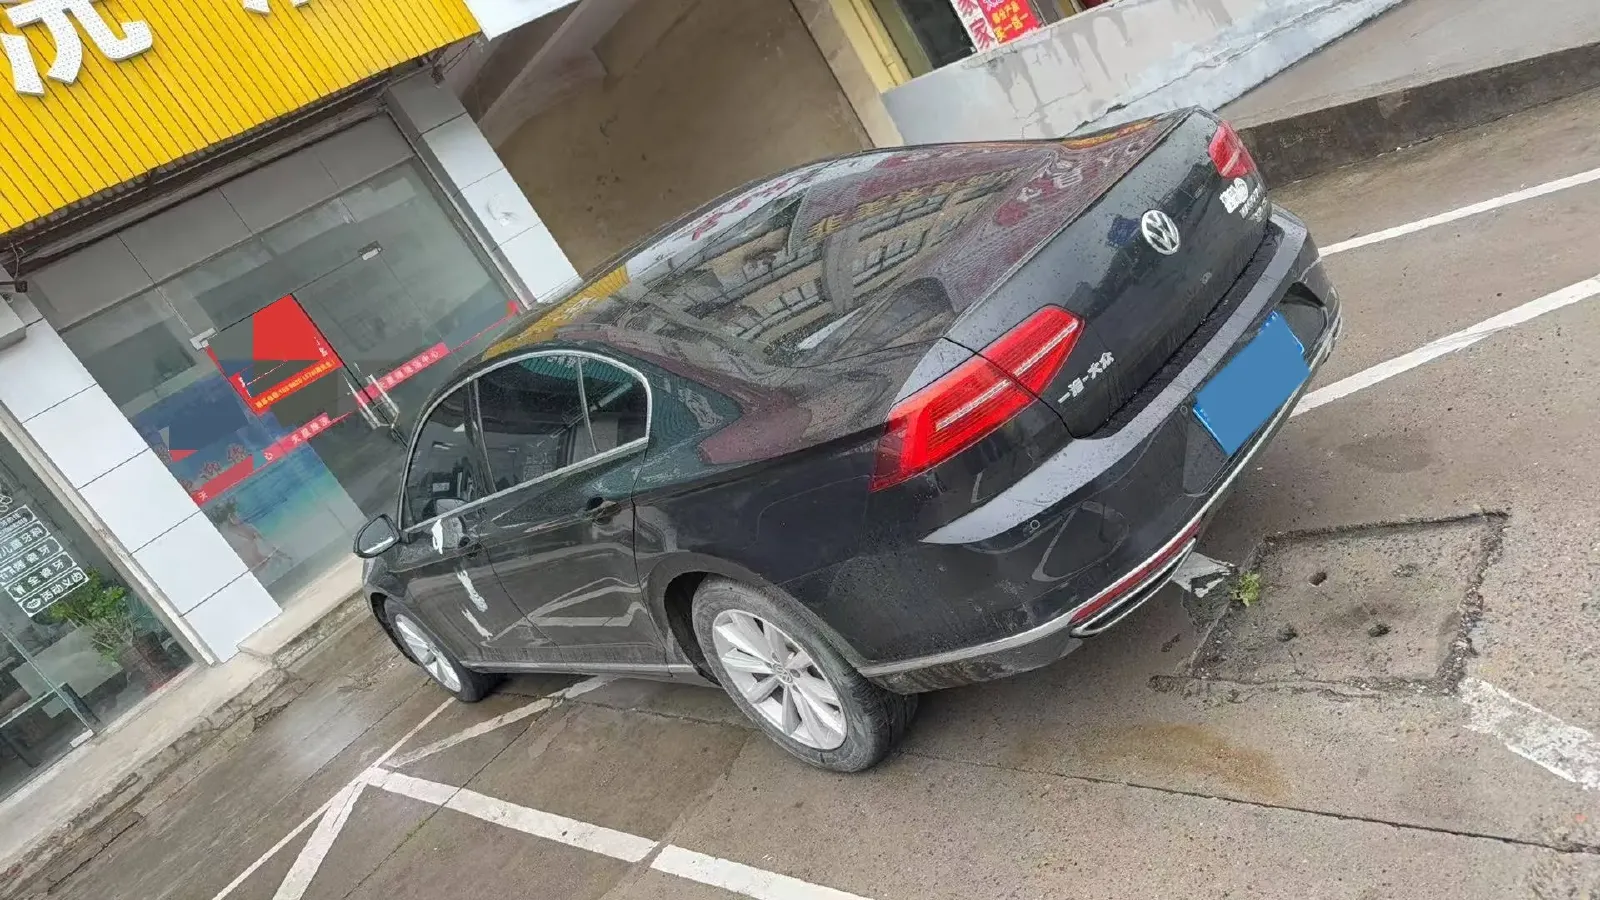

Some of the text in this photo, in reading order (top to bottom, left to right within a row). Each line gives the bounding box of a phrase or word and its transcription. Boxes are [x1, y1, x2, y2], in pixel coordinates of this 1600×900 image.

[28, 559, 64, 587] 全瓷牙
[40, 572, 84, 602] 活动义齿
